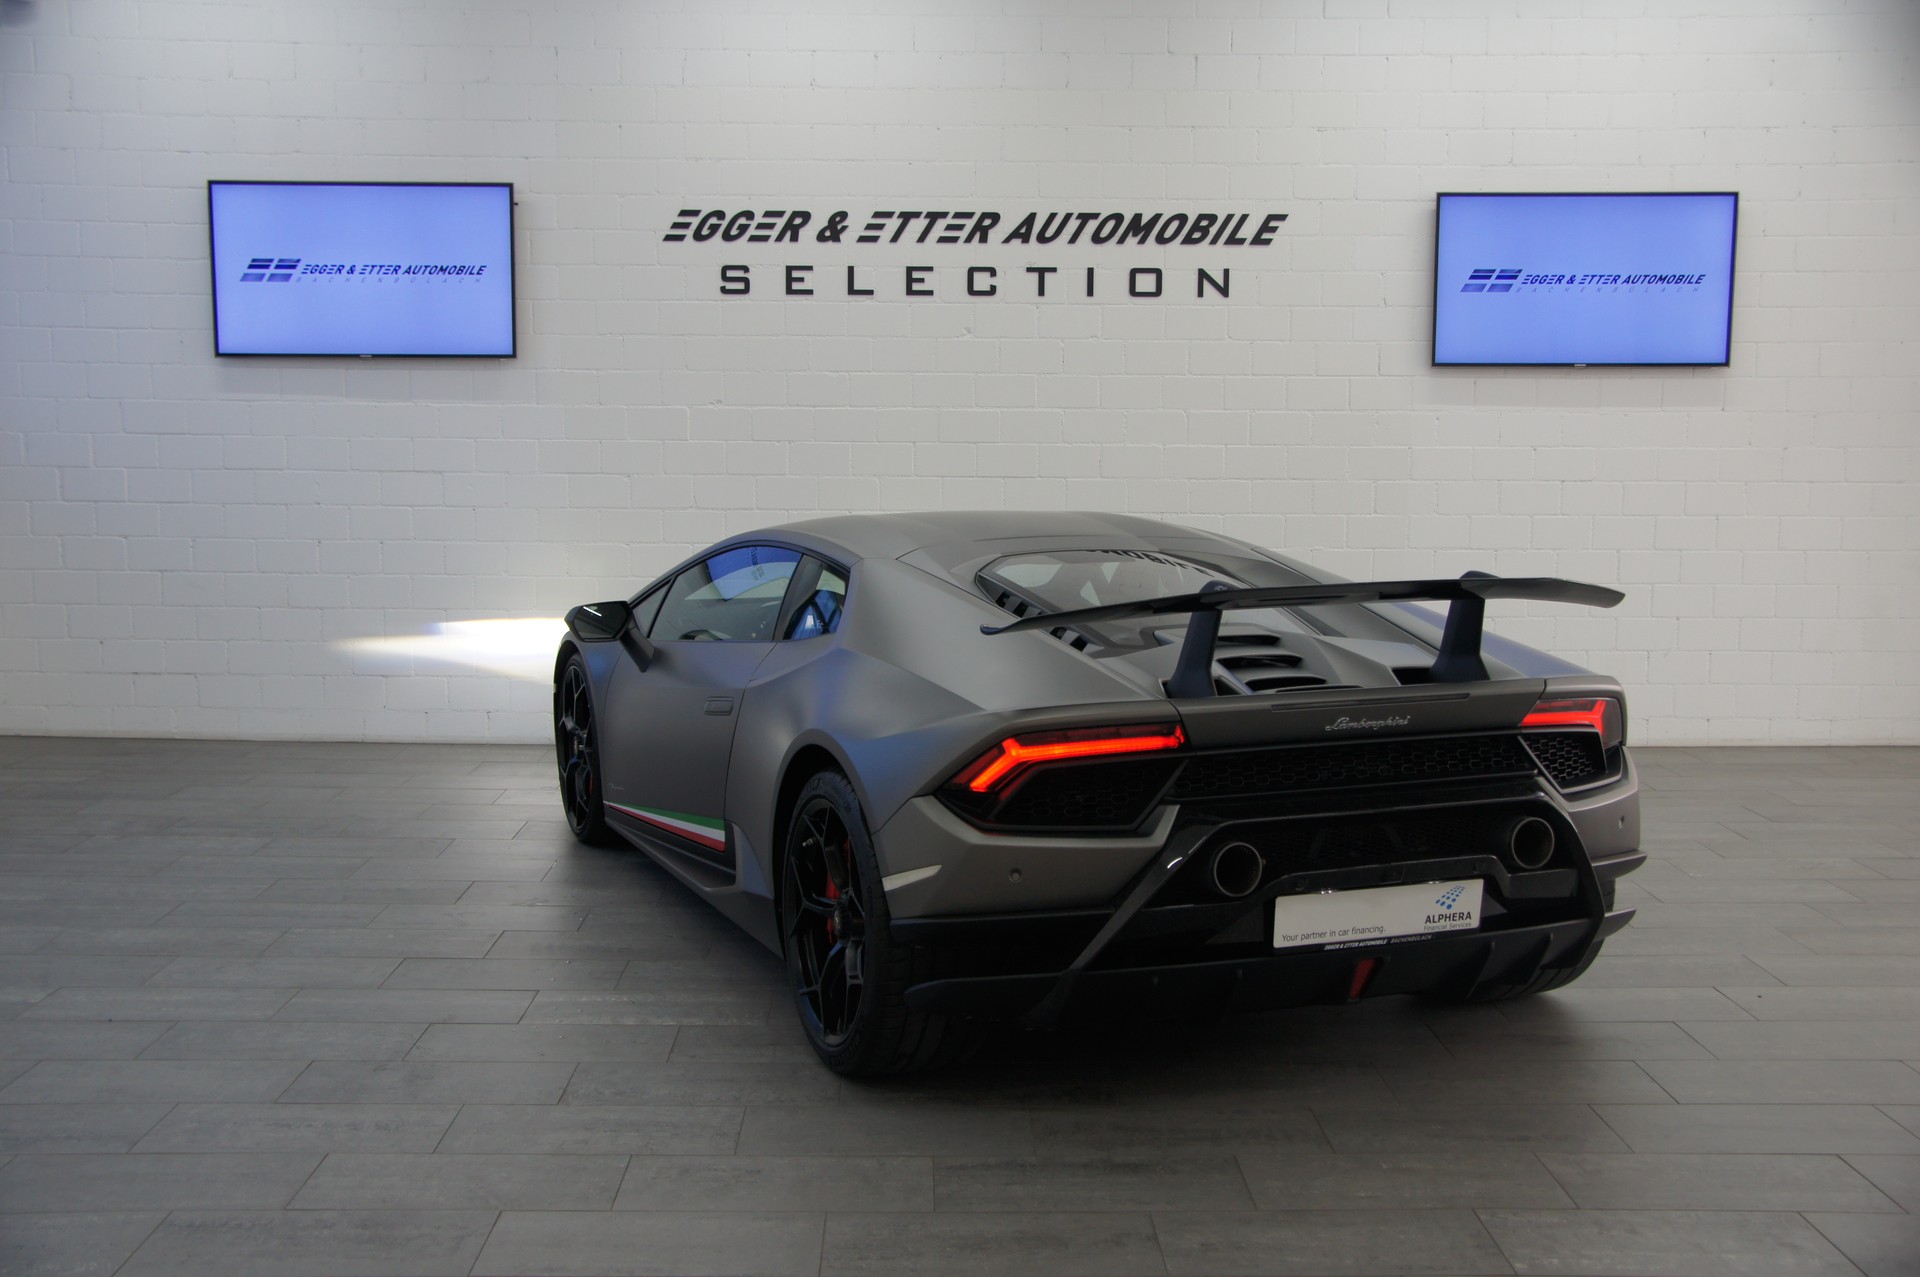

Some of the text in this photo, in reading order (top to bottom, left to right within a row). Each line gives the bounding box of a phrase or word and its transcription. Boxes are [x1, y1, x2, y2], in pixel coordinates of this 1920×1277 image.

[662, 209, 1289, 247] EGGER & ETTER AUTOMOBILE
[301, 264, 487, 276] EGGER & ETTER AUTOMOBILE
[720, 264, 1231, 299] SELECTION
[1521, 274, 1707, 285] EGGER & ETTER AUTOMOBILE
[1325, 715, 1411, 731] Lamborghini
[1424, 911, 1472, 925] ALPHERA
[1282, 924, 1386, 943] Your partner in car financing.
[1423, 921, 1472, 932] Financial Services
